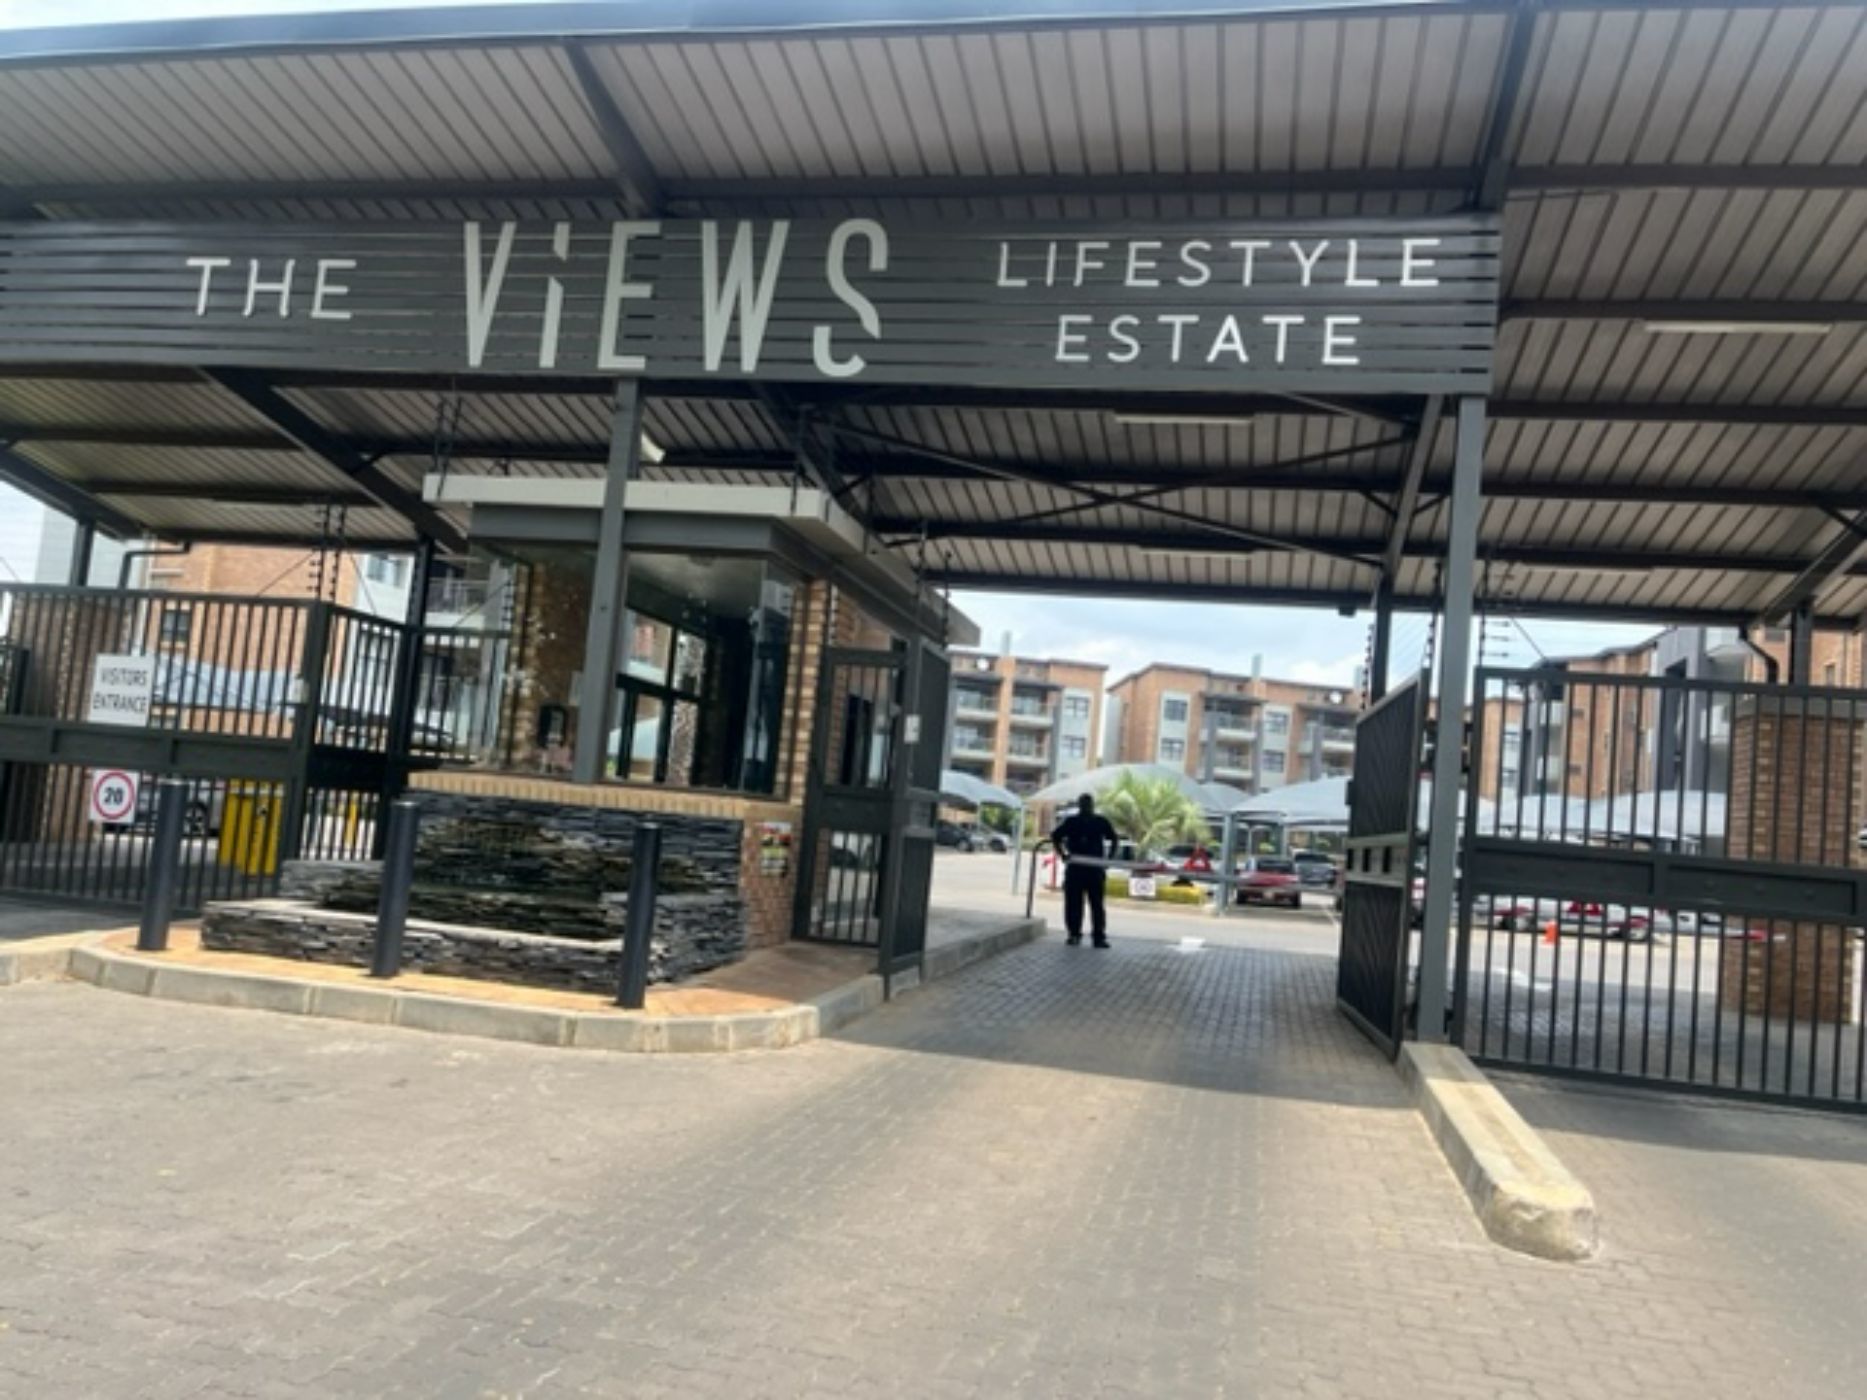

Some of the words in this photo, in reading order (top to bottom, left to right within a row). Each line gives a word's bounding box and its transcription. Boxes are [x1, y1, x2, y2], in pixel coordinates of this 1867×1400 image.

[997, 239, 1441, 287] LIFESTYLE
[186, 258, 356, 319] THE
[1056, 315, 1361, 365] ESTATE
[101, 667, 148, 686] VISITORS
[93, 692, 147, 713] ENTRANCE
[103, 786, 125, 805] 20
